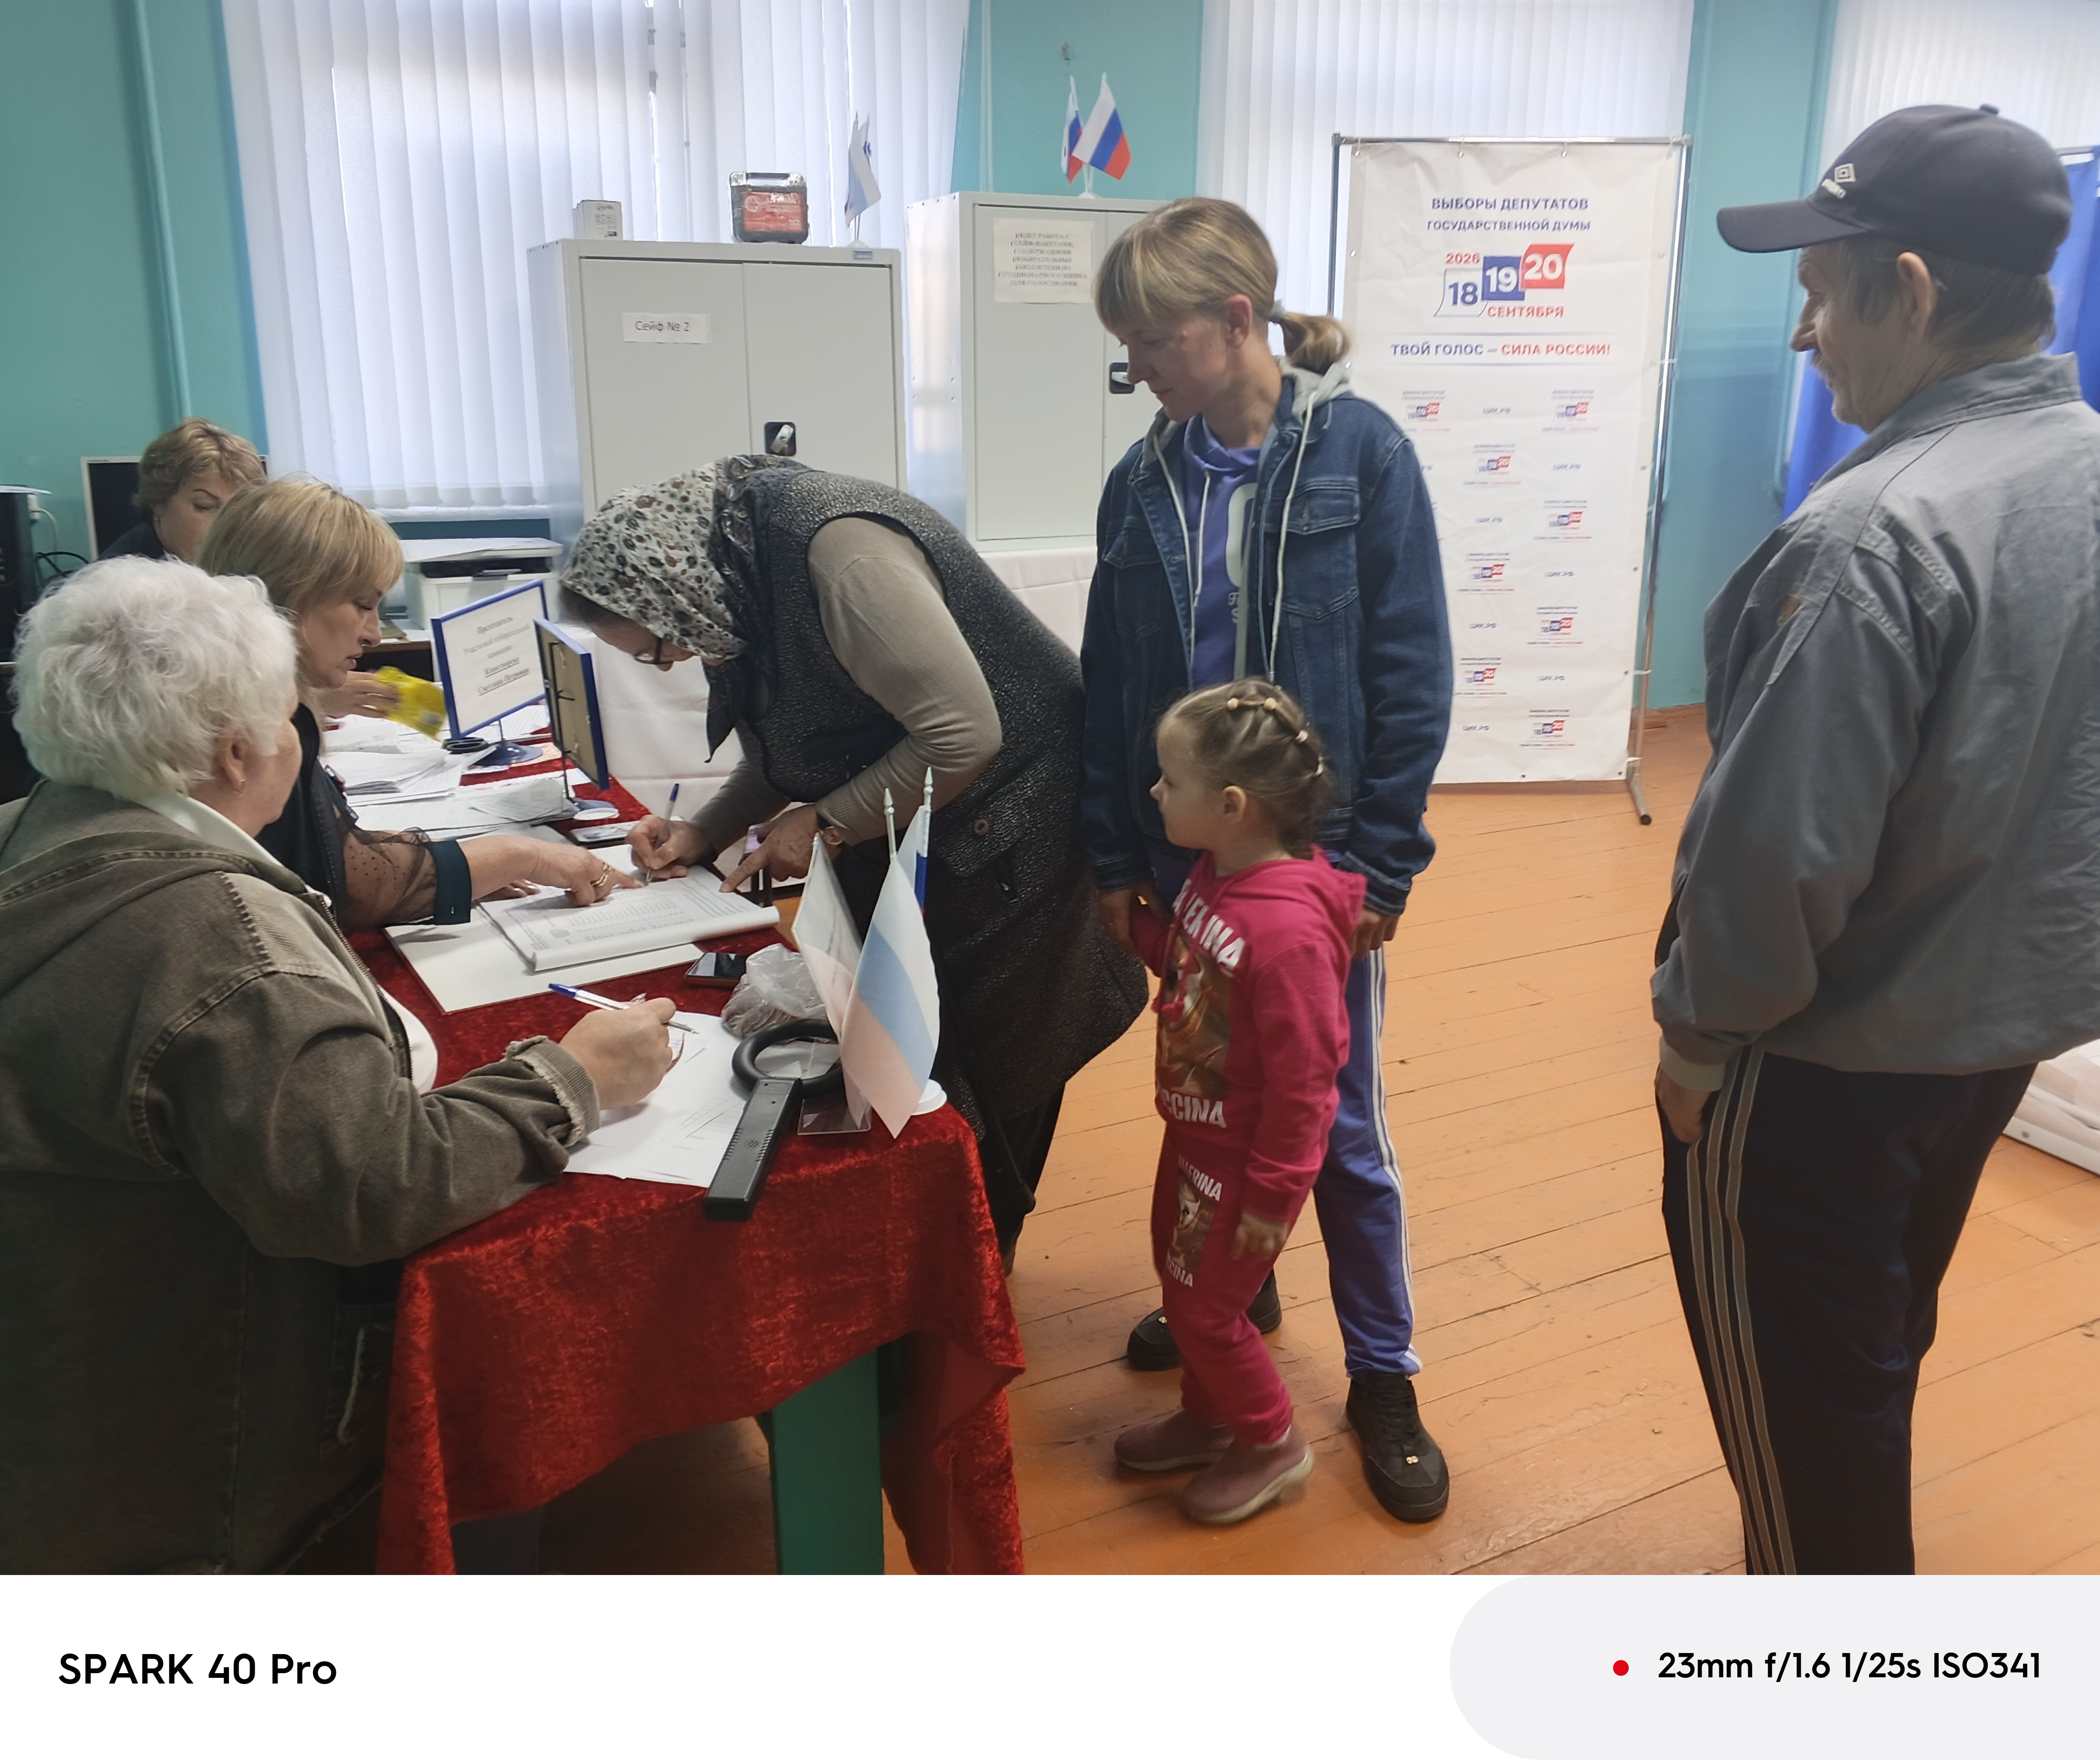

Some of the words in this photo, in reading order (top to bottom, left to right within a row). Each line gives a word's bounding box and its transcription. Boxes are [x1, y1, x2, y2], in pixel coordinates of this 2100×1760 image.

[1432, 197, 1496, 210] ВЫБОРЫ
[1501, 197, 1589, 212] ДЕПУТАТОВ
[1427, 218, 1549, 232] ГОСУДАРСТВЕННОЙ
[1553, 221, 1591, 233] ДУМЫ
[1445, 253, 1480, 265] 2026
[1448, 282, 1478, 306] 18
[1486, 267, 1518, 293] 19
[1524, 254, 1564, 280] 20
[1488, 306, 1564, 318] СЕНТЯБРЯ
[635, 320, 664, 332] Сейф
[667, 321, 681, 331] №
[683, 321, 690, 332] 2
[1391, 341, 1430, 356] ТВОЙ
[1434, 343, 1485, 356] ГОЛОС
[1501, 343, 1540, 356] СИЛА
[1546, 343, 1611, 356] РОССИИ!
